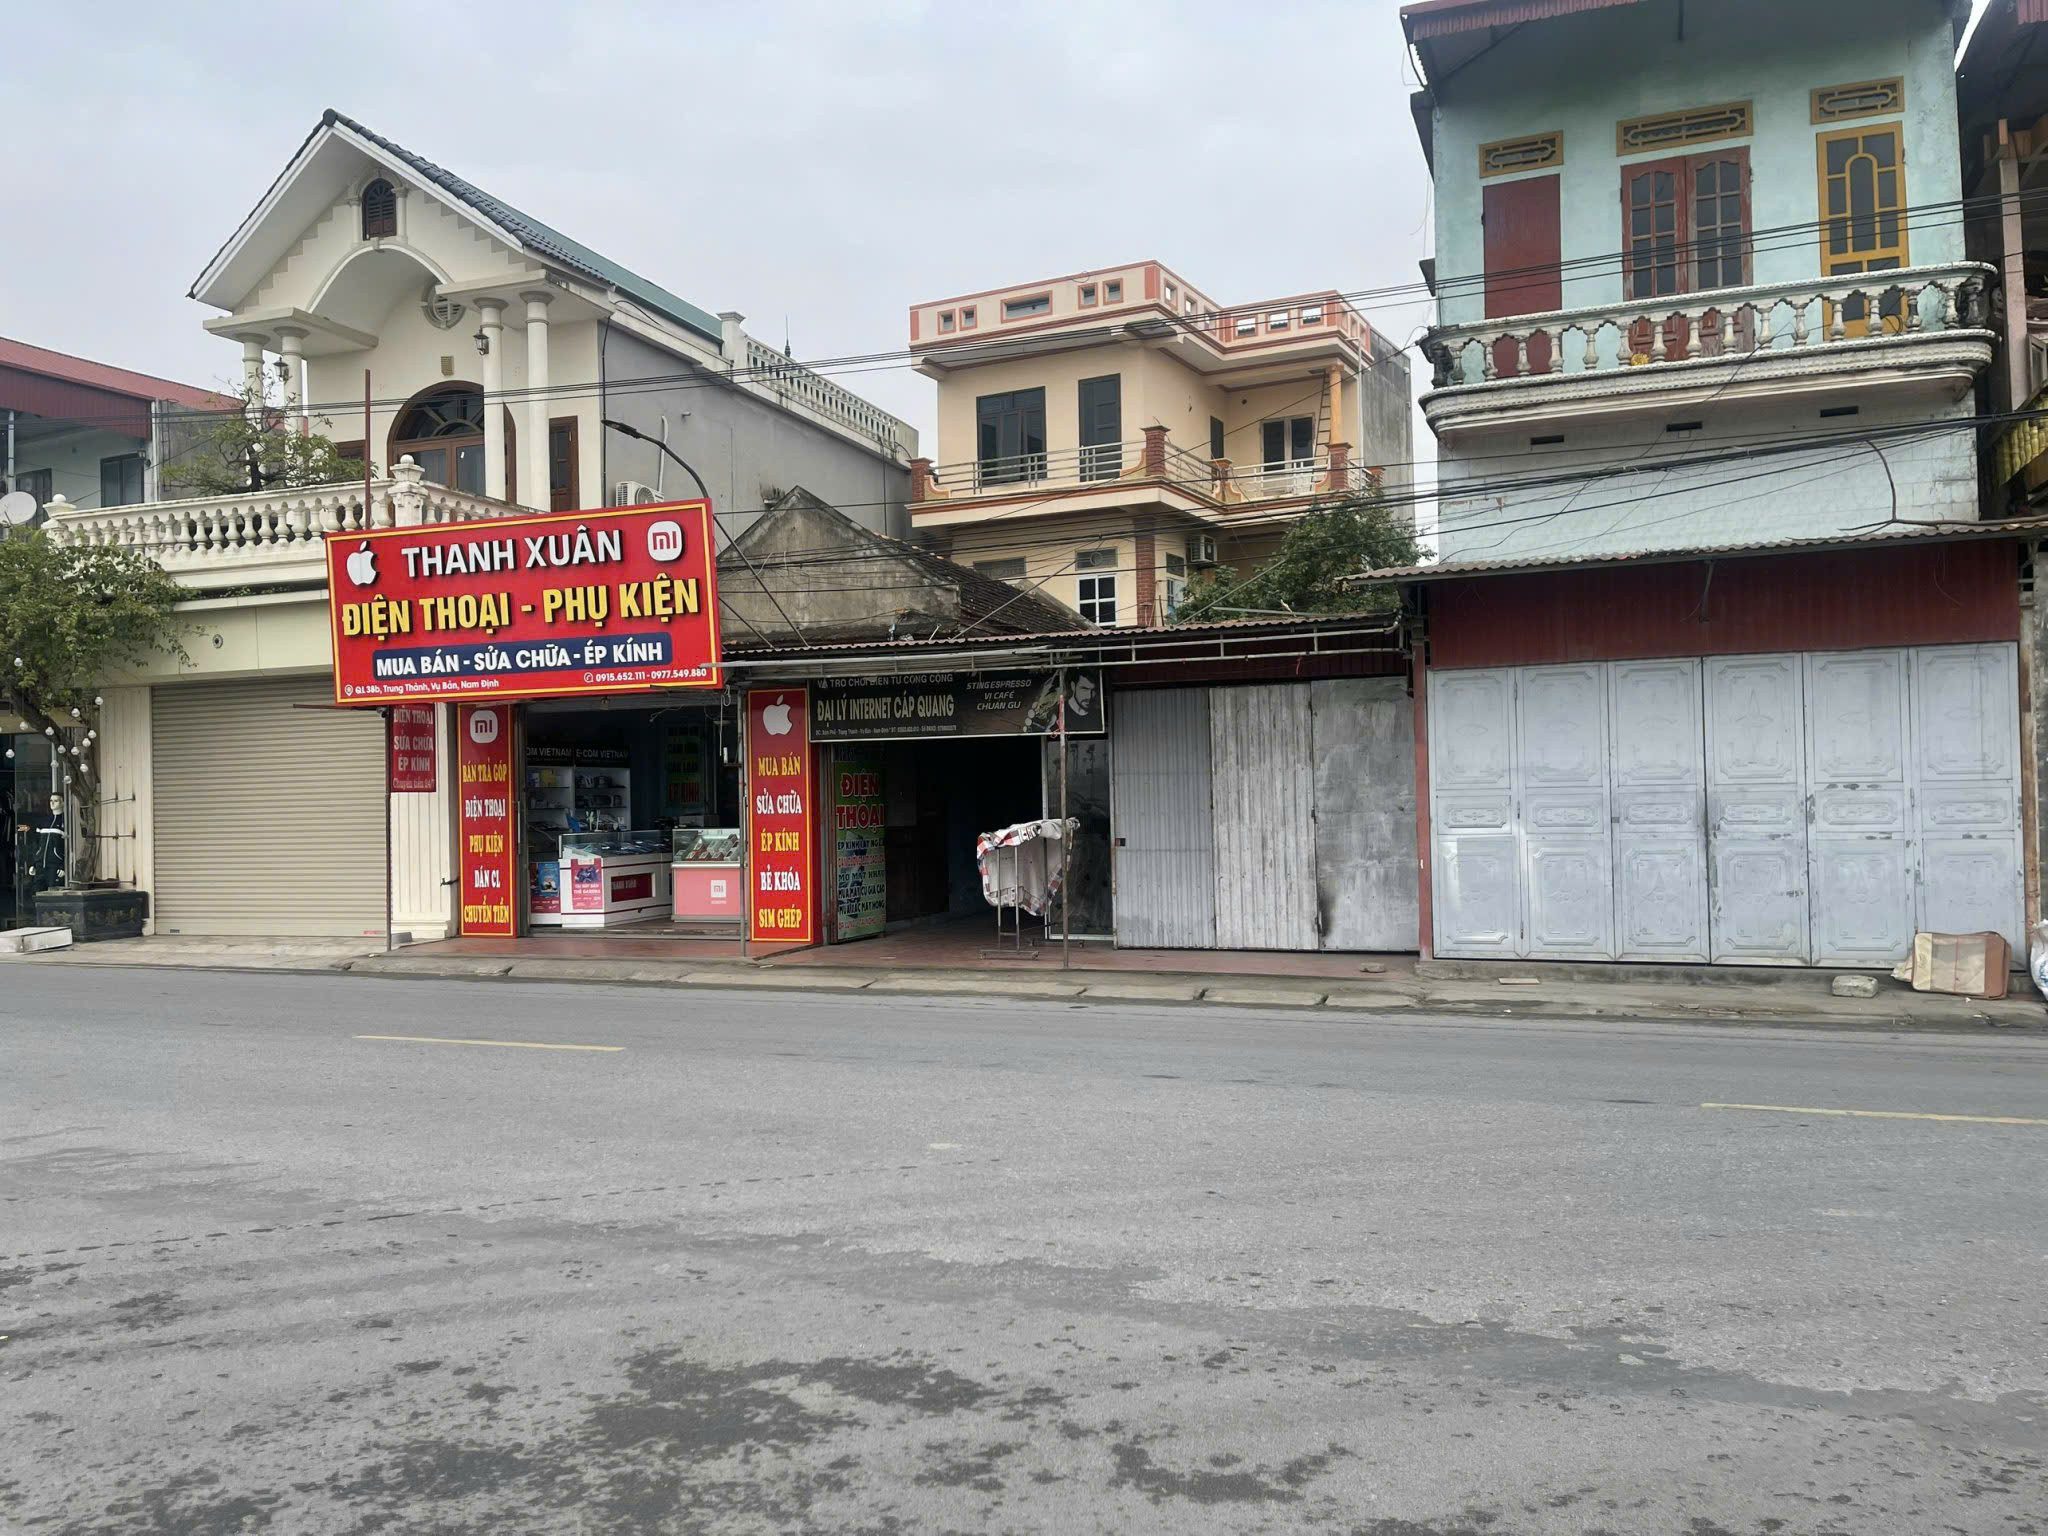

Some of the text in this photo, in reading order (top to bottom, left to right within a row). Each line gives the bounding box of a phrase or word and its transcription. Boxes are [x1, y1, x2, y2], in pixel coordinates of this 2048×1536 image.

[401, 525, 622, 578] THANH XUÂN
[342, 594, 411, 641] ĐIỆN
[419, 592, 510, 634] THOẠI
[543, 585, 609, 628] PHỤ
[619, 573, 698, 625] KIỆN
[376, 656, 416, 677] MUA
[421, 649, 460, 674] BÁN
[474, 647, 512, 671] SỬA
[516, 644, 572, 668] CHỮA
[584, 638, 608, 664] ÉP
[613, 637, 664, 662] KÍNH
[384, 684, 404, 694] Trung
[431, 682, 441, 692] Vụ
[461, 680, 480, 688] Nam
[481, 678, 500, 688] Định
[596, 672, 646, 682] 0915.652.111
[990, 679, 1032, 689] ESPRESSO
[412, 710, 433, 727] THOẠI
[817, 690, 954, 727] ĐẠI LÝ INTERNET CÁP QUANG
[398, 754, 408, 772] ÉP
[462, 764, 478, 783] BÁN
[493, 762, 508, 782] GÓP
[758, 752, 801, 776] MUA BÁN
[840, 769, 880, 802] ĐIỆN
[466, 794, 506, 822] ĐIỆN THOẠI
[756, 788, 802, 814] SỬA CHỮA
[836, 804, 885, 833] THOẠI
[470, 830, 504, 857] PHỤ KIỆN
[760, 828, 800, 852] ÉP KÍNH
[492, 872, 500, 888] CL
[760, 864, 801, 891] BẺ KHÓA
[759, 904, 802, 928] SIM GHÉP
